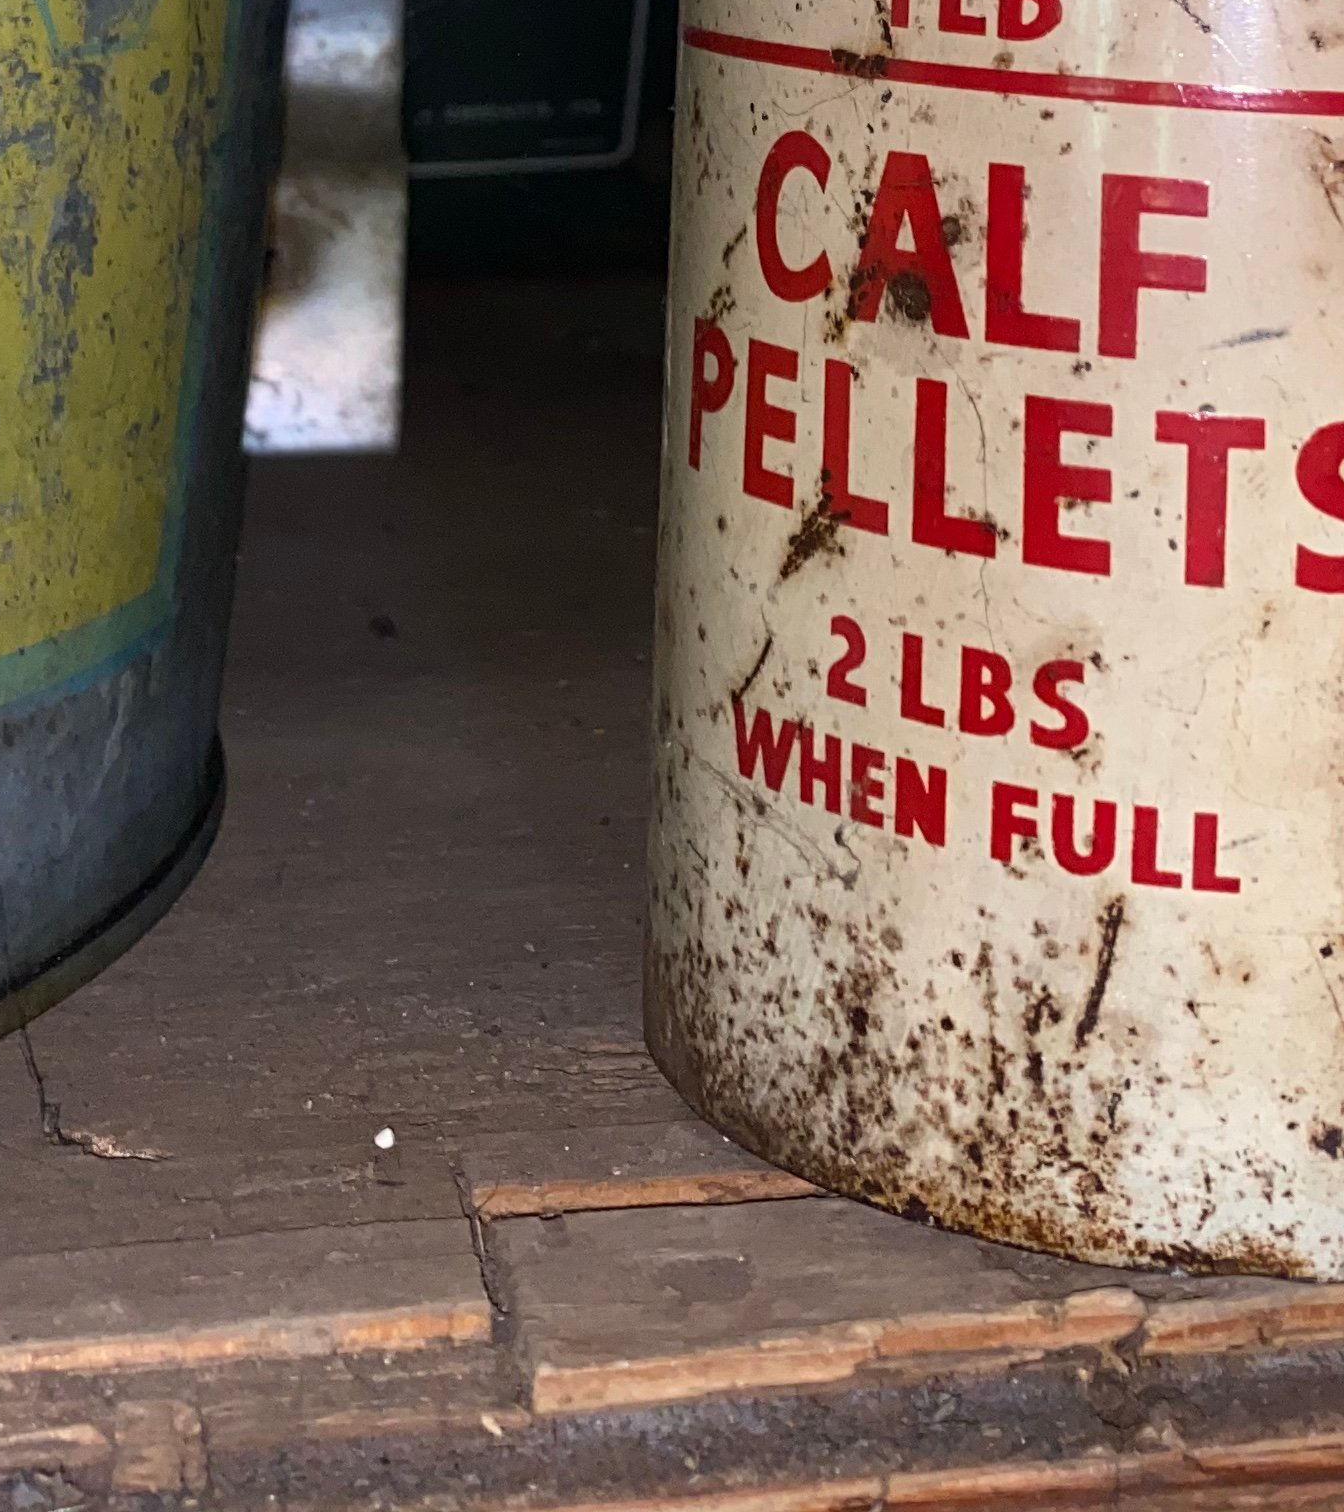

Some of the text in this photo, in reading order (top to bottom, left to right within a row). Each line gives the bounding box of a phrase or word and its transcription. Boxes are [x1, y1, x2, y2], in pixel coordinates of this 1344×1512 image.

[755, 129, 1210, 360] CALF
[825, 615, 1091, 751] 2 LBS
[731, 700, 1242, 894] WHEN FULL
